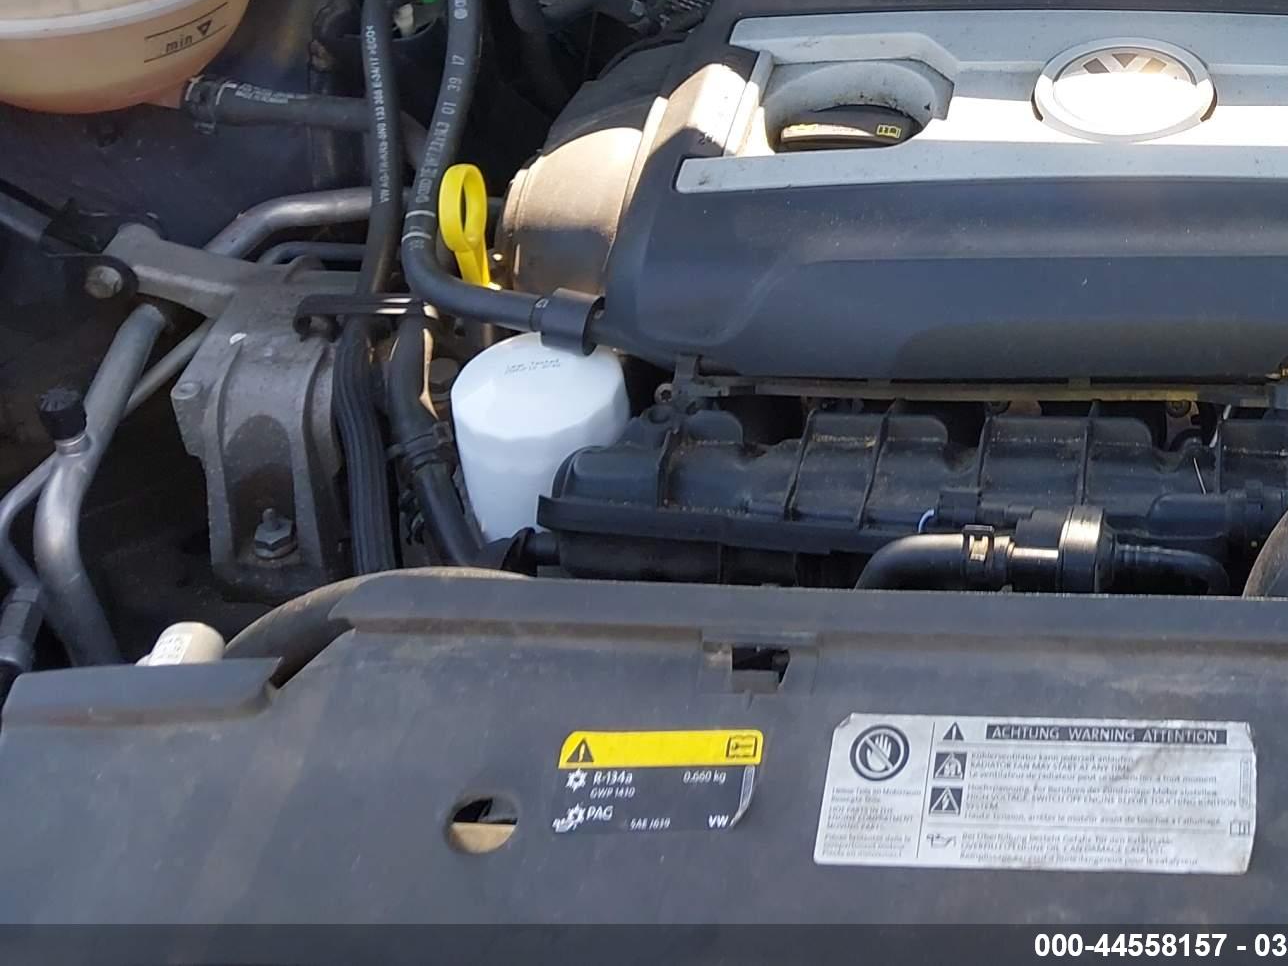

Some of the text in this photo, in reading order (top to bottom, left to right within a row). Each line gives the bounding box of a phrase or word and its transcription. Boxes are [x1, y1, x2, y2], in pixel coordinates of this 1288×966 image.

[166, 35, 193, 53] min
[992, 725, 1217, 744] ACHTUNG WARNING ATTENTION
[593, 770, 633, 786] R-134a
[713, 769, 726, 785] kg
[590, 787, 614, 798] GWP
[586, 805, 614, 820] PAG
[708, 814, 729, 828] VW
